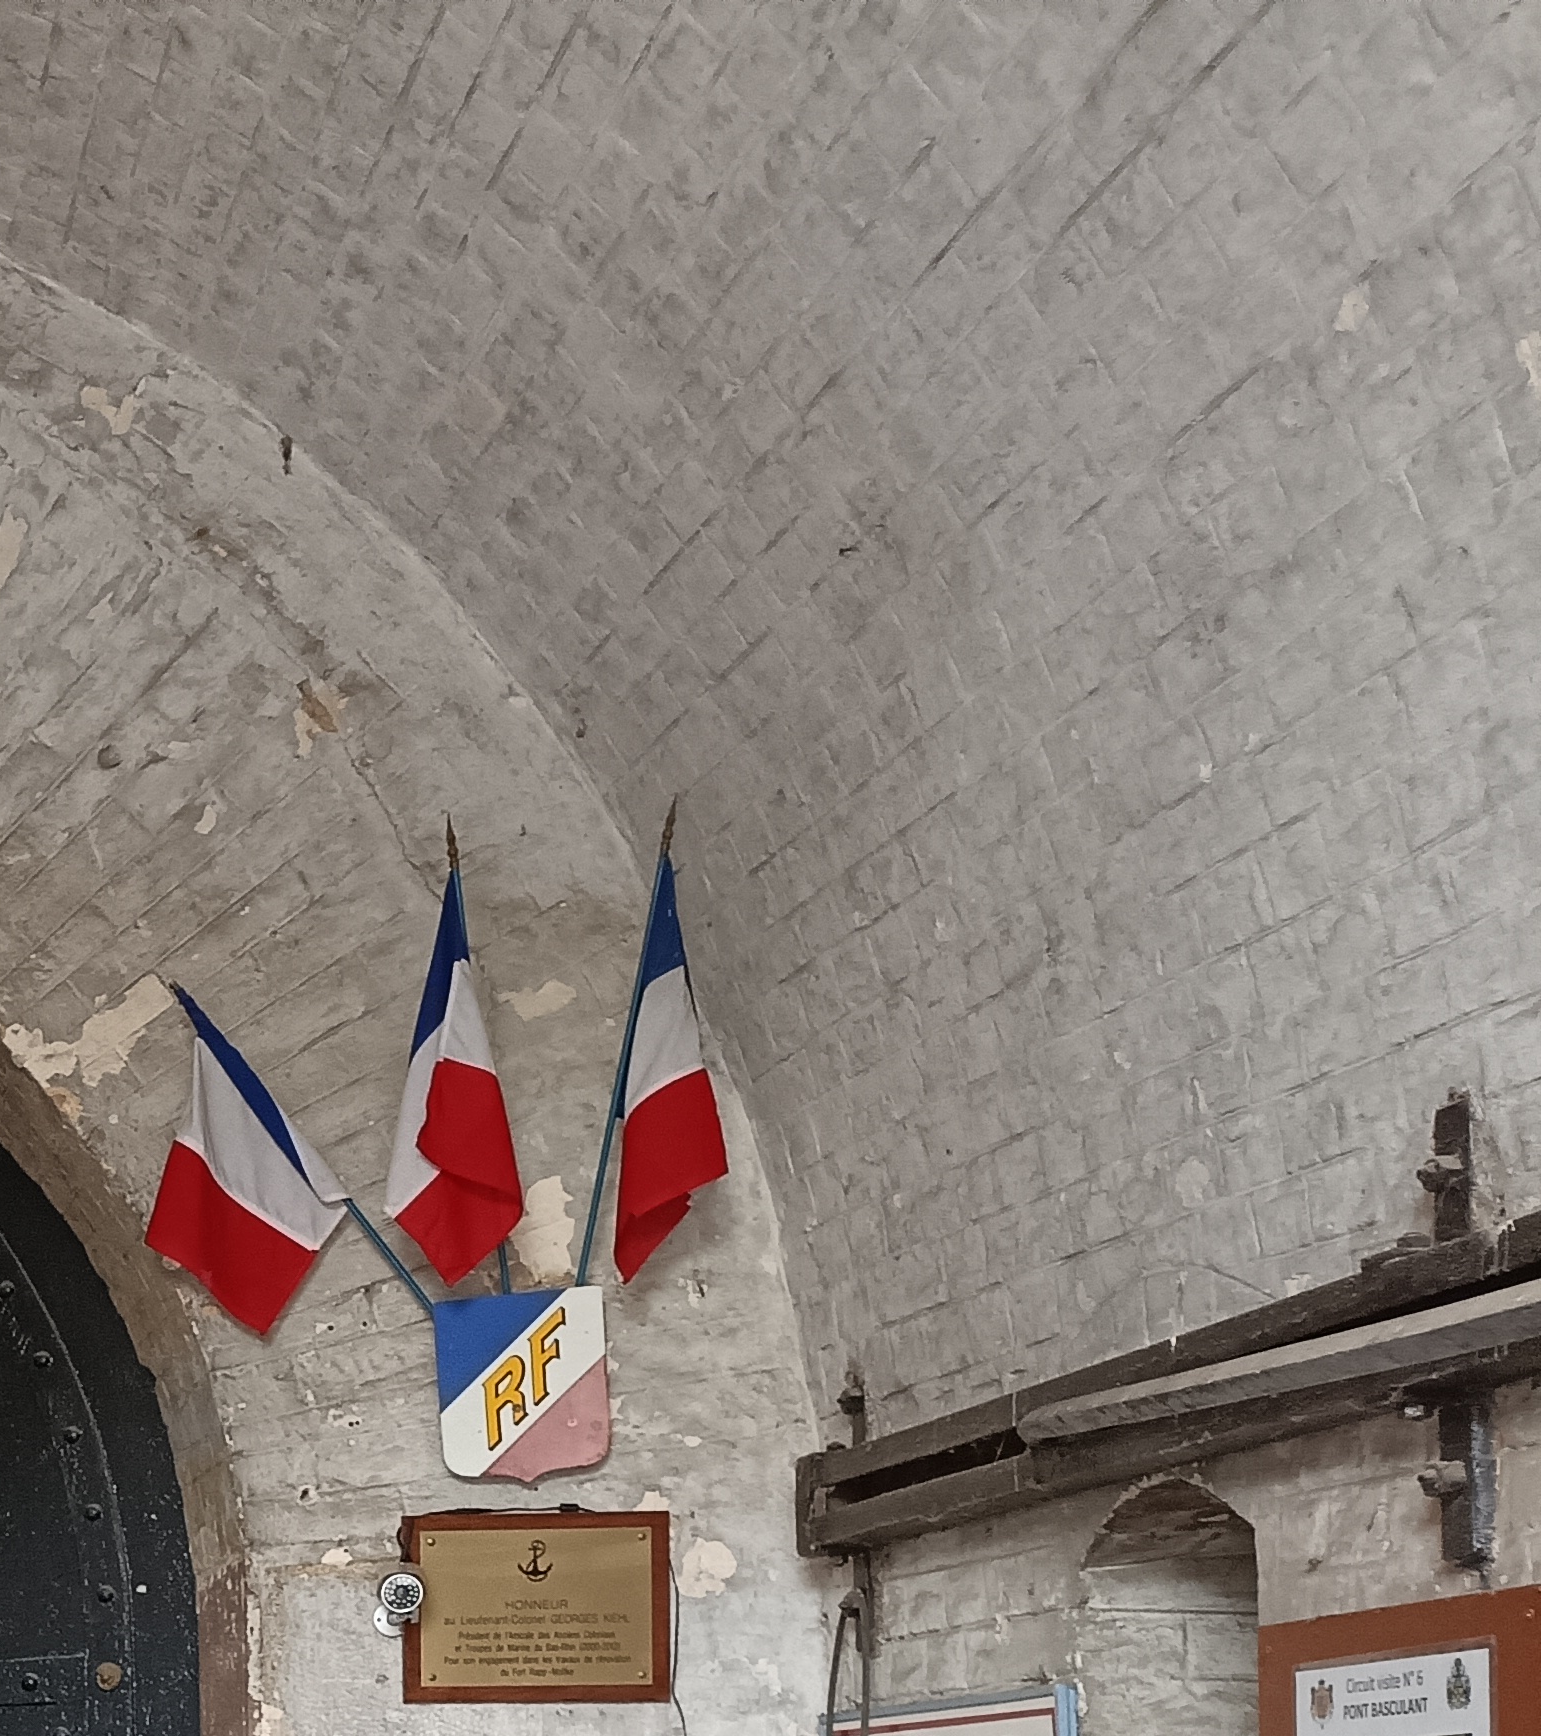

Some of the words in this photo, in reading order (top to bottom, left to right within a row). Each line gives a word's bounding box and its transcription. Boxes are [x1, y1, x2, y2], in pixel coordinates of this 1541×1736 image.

[481, 1306, 565, 1450] RF
[505, 1599, 568, 1610] HONNEUR
[1346, 1676, 1375, 1694] Circuit
[1377, 1673, 1401, 1690] visite
[1343, 1703, 1369, 1720] PONT
[1371, 1697, 1428, 1718] BASCULANT
